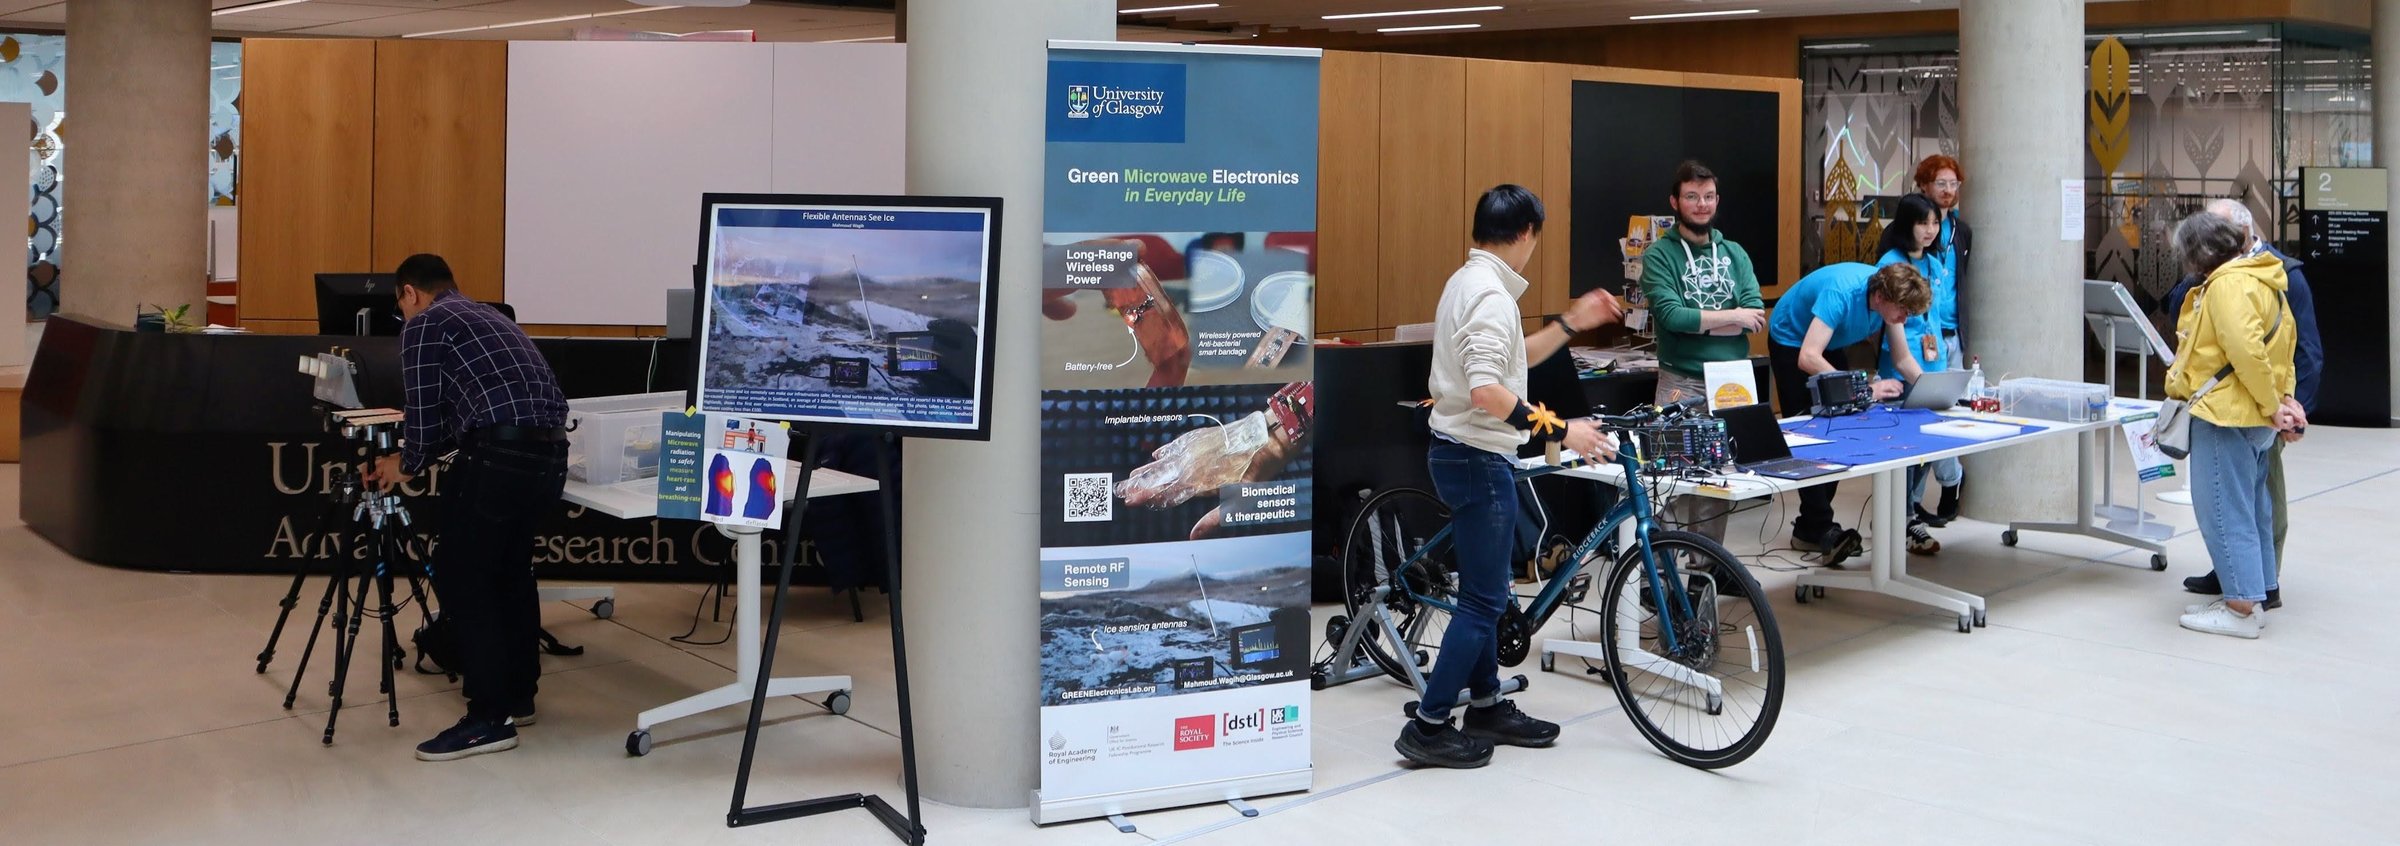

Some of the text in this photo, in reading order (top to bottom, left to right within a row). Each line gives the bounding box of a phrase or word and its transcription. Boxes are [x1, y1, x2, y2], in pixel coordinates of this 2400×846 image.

[1093, 86, 1164, 104] University
[1093, 101, 1164, 118] of Glasgow
[1068, 168, 1299, 184] Green Microwave Electronics
[2319, 172, 2331, 191] 2
[1125, 188, 1245, 205] in Everyday Life
[802, 212, 895, 222] Flexible Antennas See Ice
[1067, 250, 1133, 261] Long-Range
[1066, 262, 1114, 272] Wireless
[1066, 275, 1101, 285] Power
[365, 279, 375, 293] hp
[1199, 331, 1261, 340] Wirelessly powered
[1217, 348, 1246, 357] bandage
[1065, 362, 1113, 372] Battery-free
[1104, 414, 1182, 425] Implantable sensors
[665, 430, 701, 439] Manipulating
[670, 448, 695, 456] radiation
[678, 457, 695, 466] safely
[667, 475, 696, 483] heart-rate
[1241, 484, 1295, 497] Biomedical
[659, 493, 701, 502] breathing-rate
[1257, 497, 1295, 508] sensors
[1226, 509, 1295, 524] & therapeutics
[1572, 517, 1608, 560] RIDGEBACK
[1064, 562, 1124, 574] Remote RF
[1064, 577, 1109, 588] Sensing
[1104, 620, 1187, 633] Ice sensing antennas
[1183, 670, 1293, 688] Mahmoud.Wagih@Glasgow.ac.uk
[1061, 684, 1156, 700] GREENElectronicsLab.org
[1180, 728, 1202, 736] ROYAL
[1180, 734, 1209, 743] SOCIETY
[1049, 750, 1067, 758] Royal
[1057, 755, 1095, 764] Engineering
